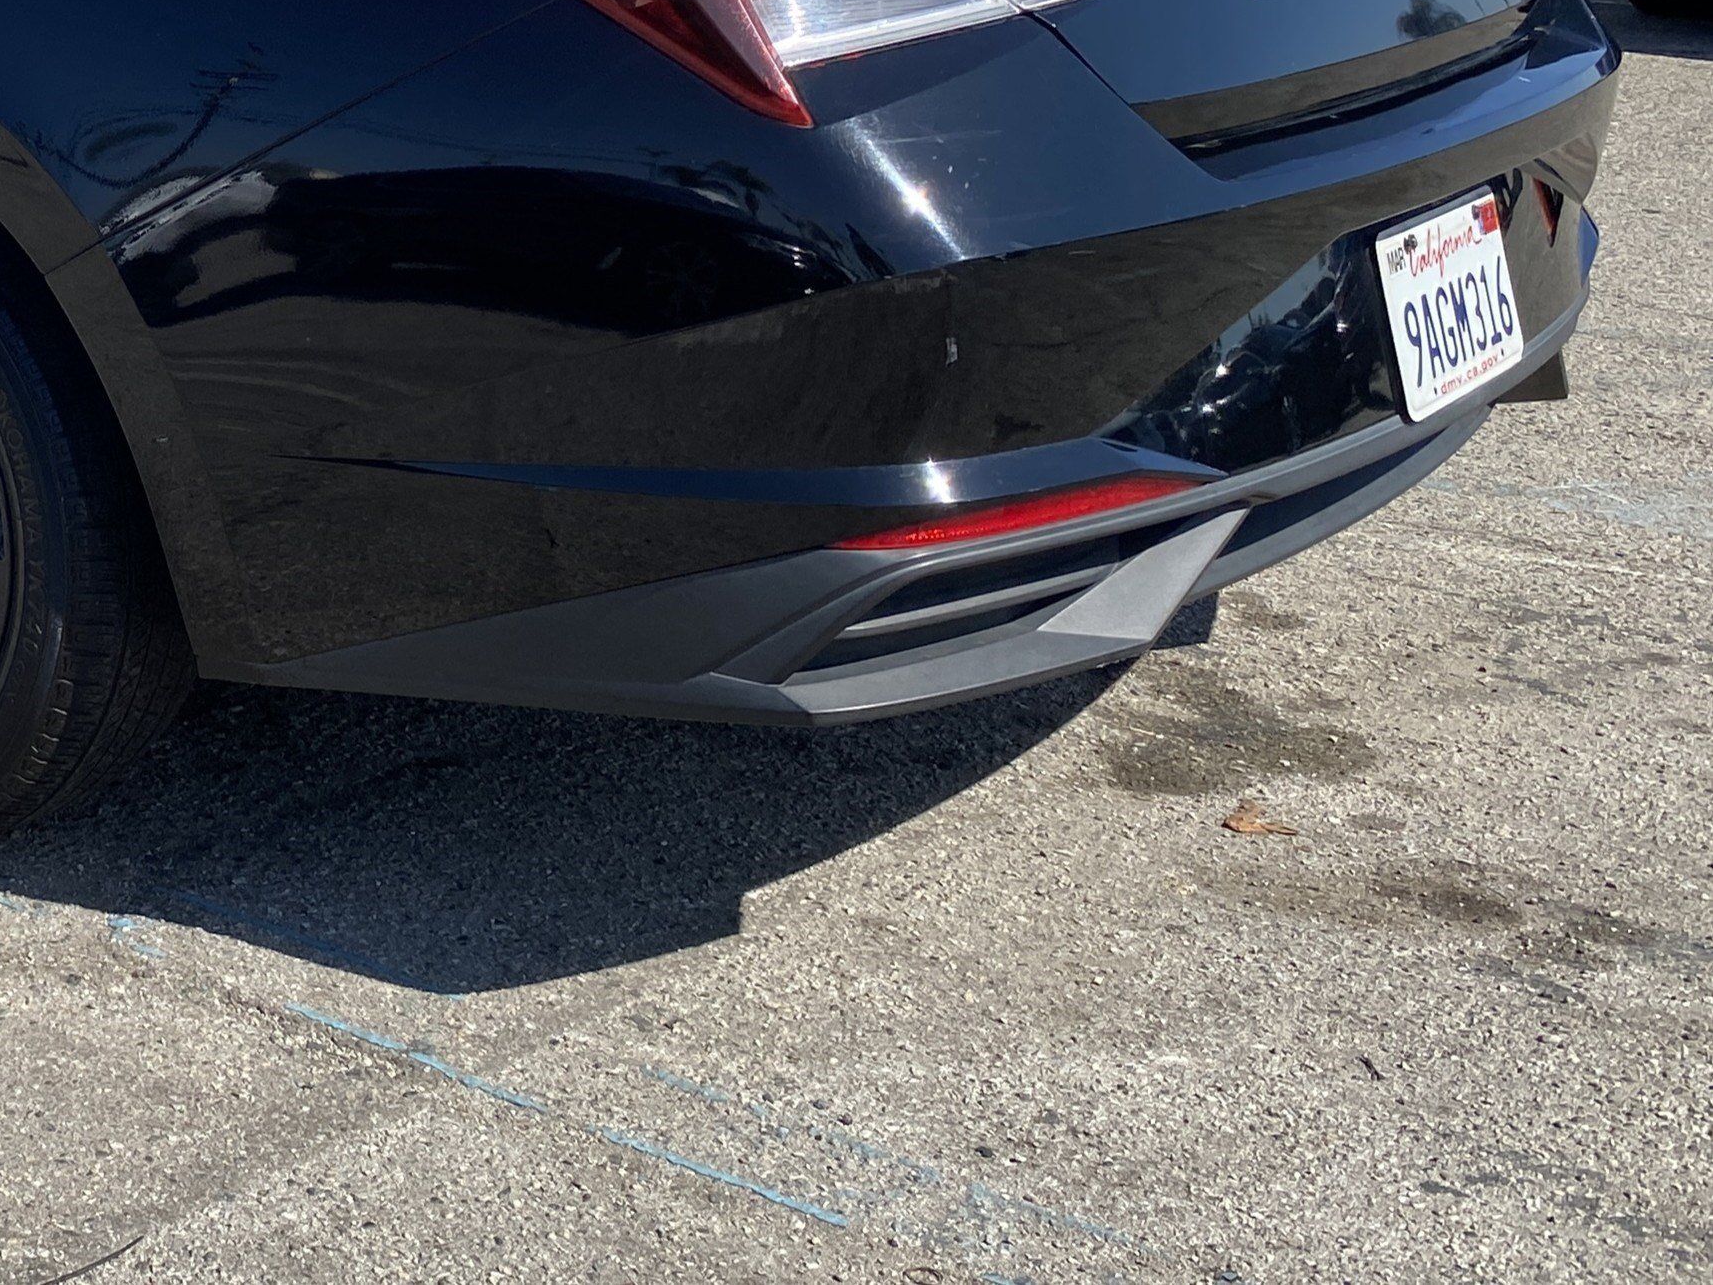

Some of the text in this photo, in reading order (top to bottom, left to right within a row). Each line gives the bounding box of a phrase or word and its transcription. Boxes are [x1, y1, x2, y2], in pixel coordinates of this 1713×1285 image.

[1407, 224, 1482, 278] California
[1403, 255, 1514, 389] 9AGM316
[1440, 353, 1499, 396] dmv.ca.gov
